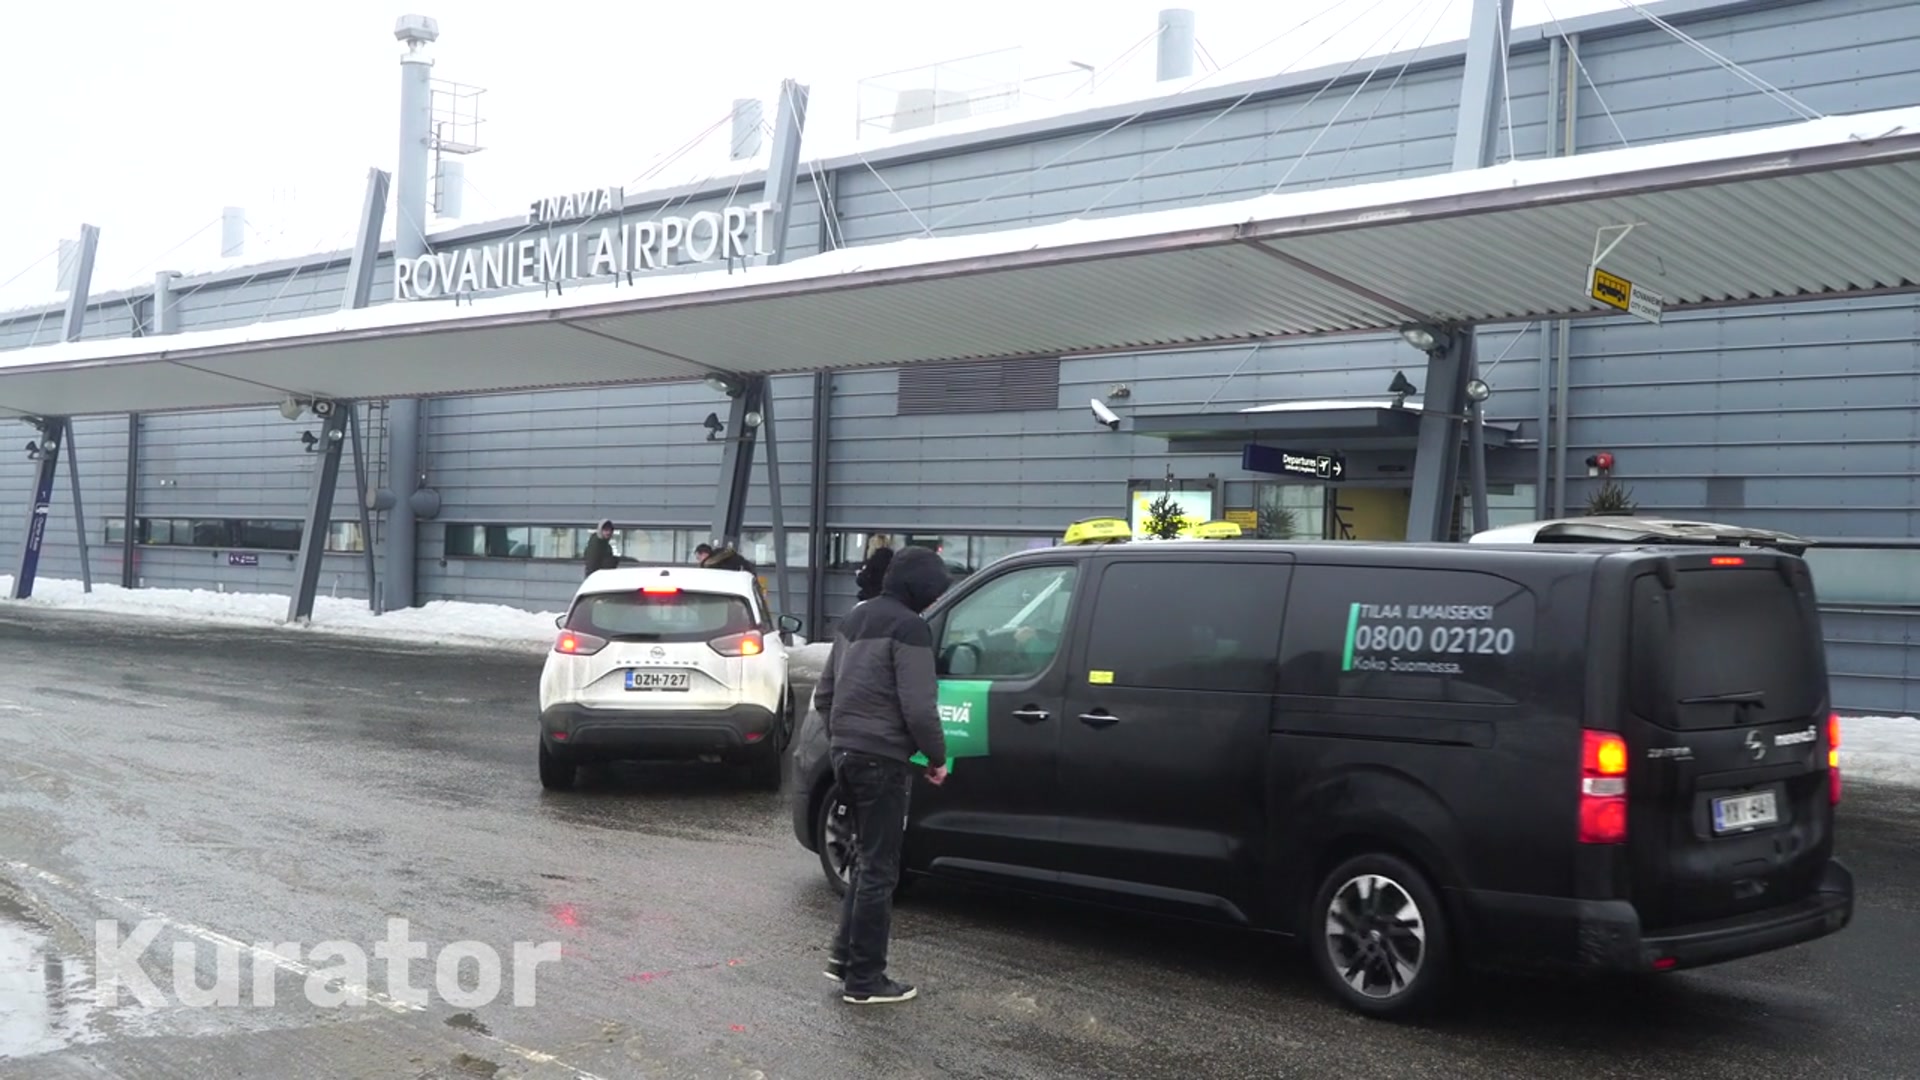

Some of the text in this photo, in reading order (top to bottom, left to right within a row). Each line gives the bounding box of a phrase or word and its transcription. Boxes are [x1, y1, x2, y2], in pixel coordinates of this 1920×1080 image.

[525, 187, 616, 225] FINAVIA
[393, 202, 774, 299] ROVANIEMI AIRPORT
[1283, 454, 1316, 467] Departures
[1360, 604, 1493, 620] TILAA ILMAISEKSI
[1355, 625, 1514, 654] 0800 02120
[1352, 656, 1387, 671] Koko
[634, 674, 687, 686] OZH-727
